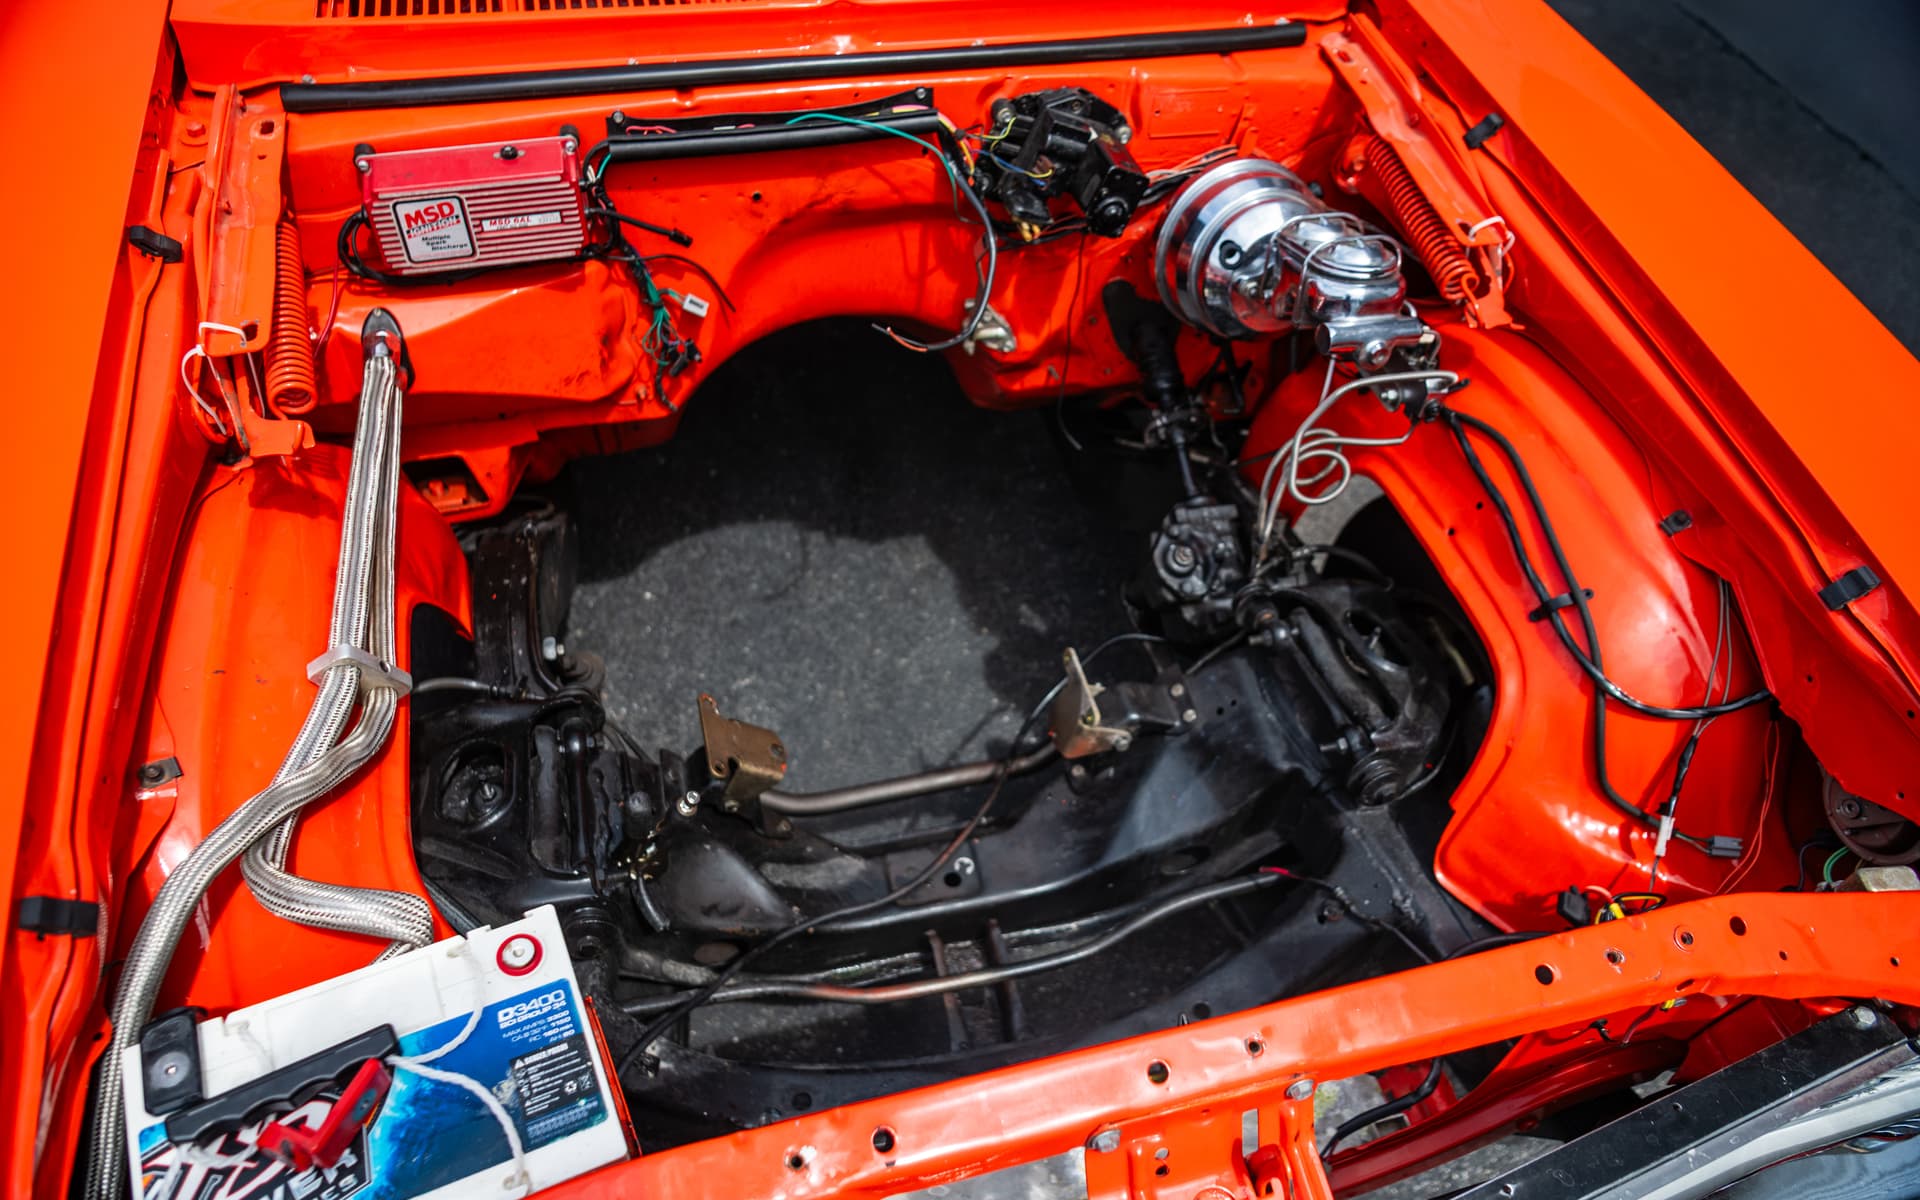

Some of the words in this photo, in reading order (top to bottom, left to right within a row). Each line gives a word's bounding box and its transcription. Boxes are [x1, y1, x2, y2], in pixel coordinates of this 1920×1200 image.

[404, 201, 455, 229] MSD
[497, 989, 566, 1023] D3400
[517, 1005, 552, 1023] GROUP
